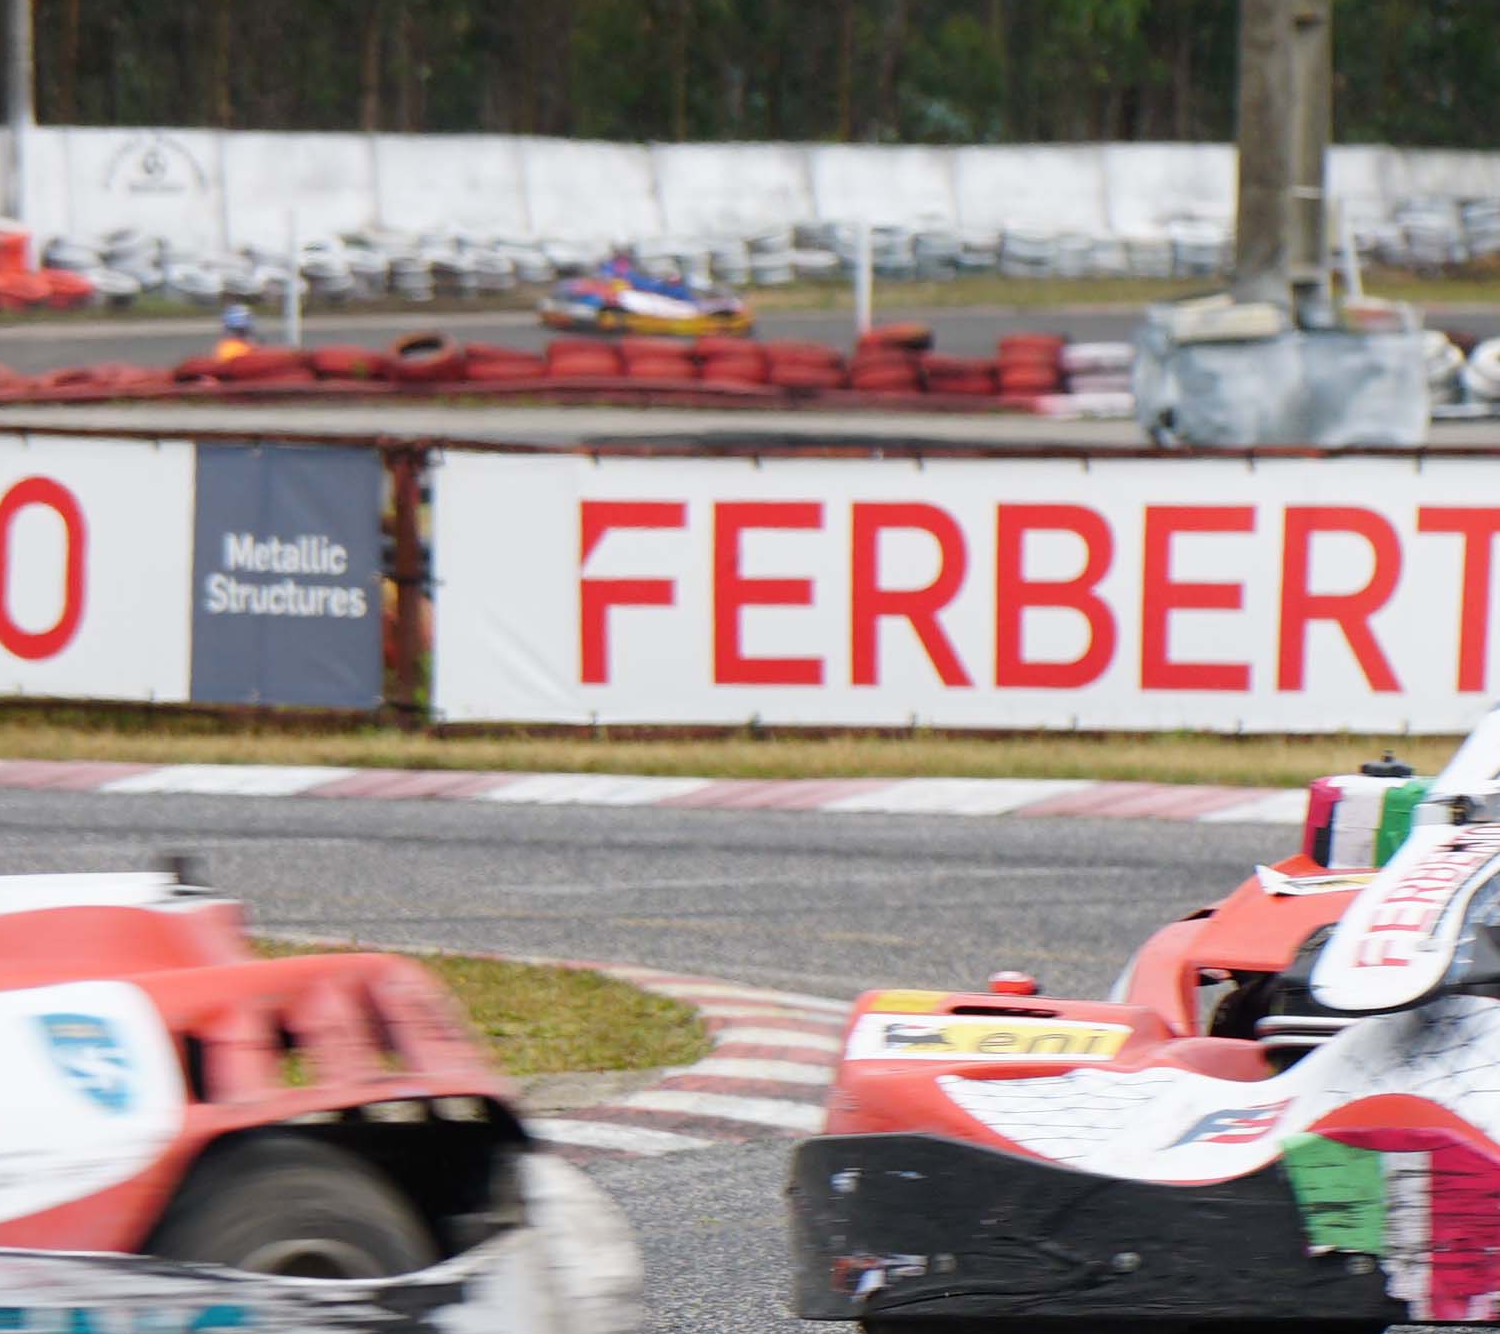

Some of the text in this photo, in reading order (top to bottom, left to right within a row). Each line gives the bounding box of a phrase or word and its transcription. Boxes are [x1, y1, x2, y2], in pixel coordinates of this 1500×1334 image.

[224, 532, 348, 574] Metallic
[205, 573, 367, 618] Structures
[979, 1028, 1112, 1055] eni
